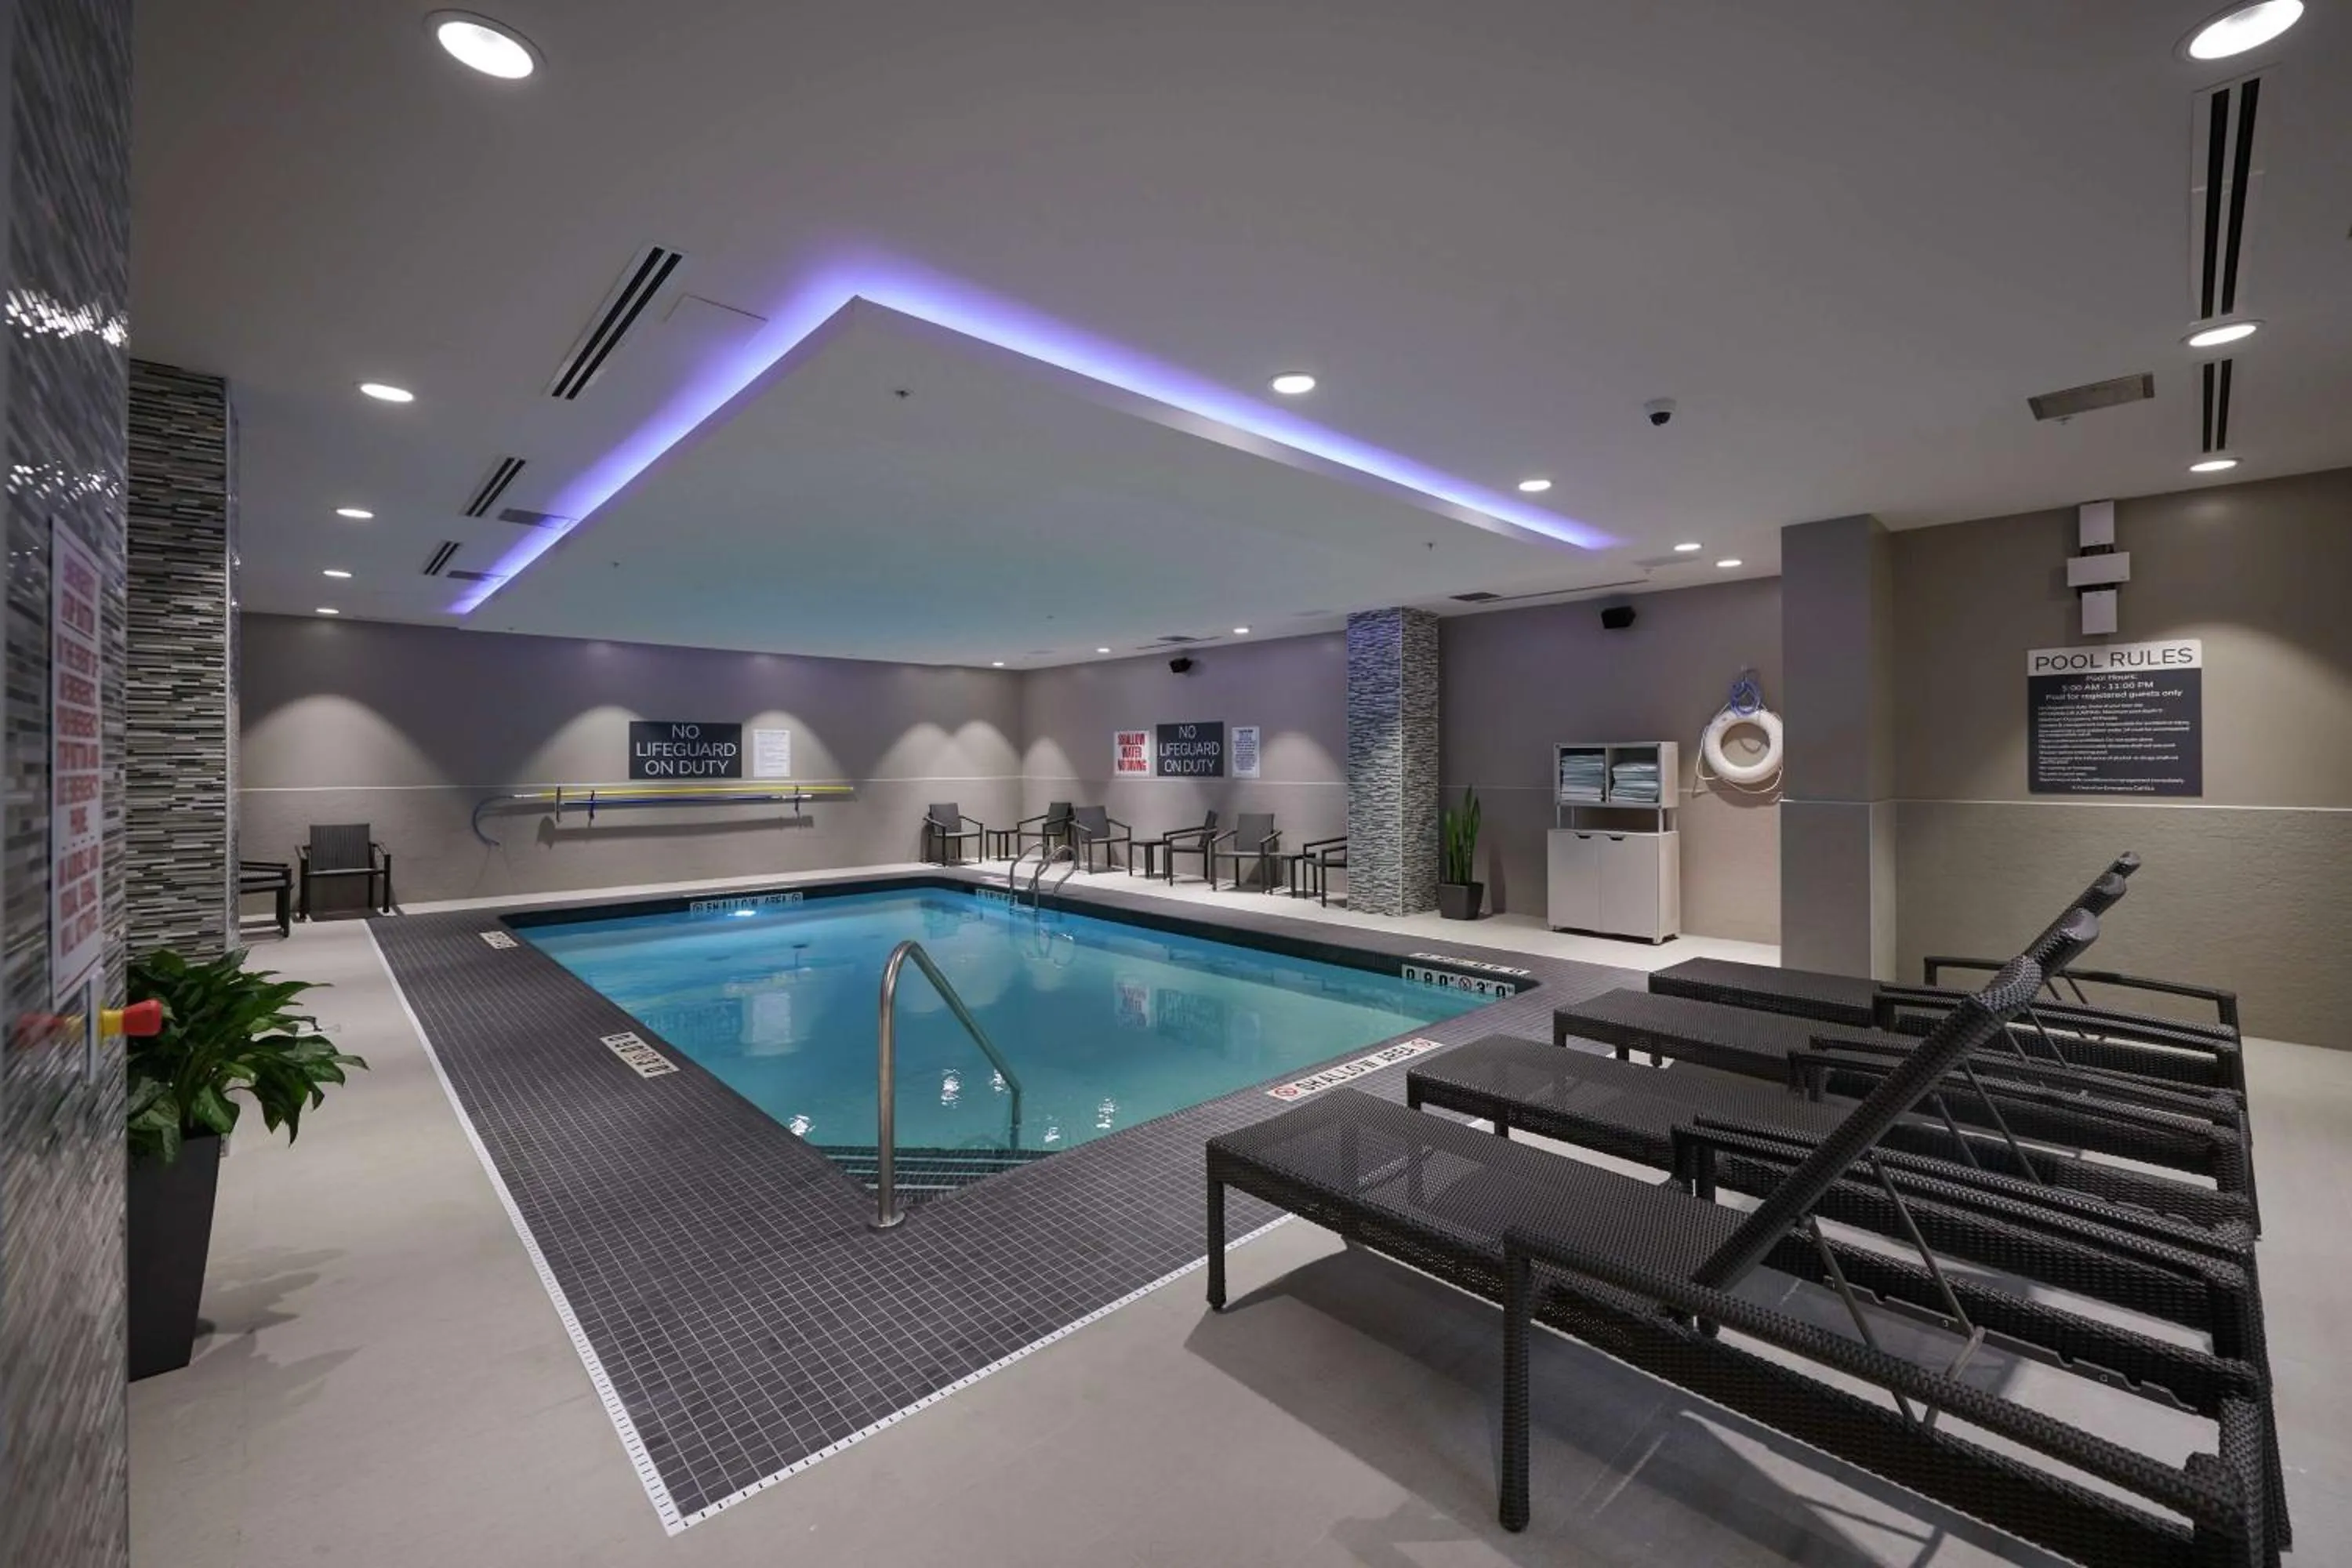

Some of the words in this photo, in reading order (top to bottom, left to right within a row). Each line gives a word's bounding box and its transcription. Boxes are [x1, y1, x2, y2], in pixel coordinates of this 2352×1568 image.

[2034, 653, 2103, 671] POOL
[2110, 647, 2193, 667] RULES
[672, 724, 700, 739] NO
[1178, 725, 1196, 739] NO
[636, 741, 736, 757] LIFEGUARD
[1160, 741, 1221, 757] LIFEGUARD
[645, 760, 673, 775] ON
[679, 760, 729, 775] DUTY
[1164, 758, 1181, 772] ON
[1183, 757, 1215, 774] DUTY
[1295, 1059, 1379, 1091] SHALLOW
